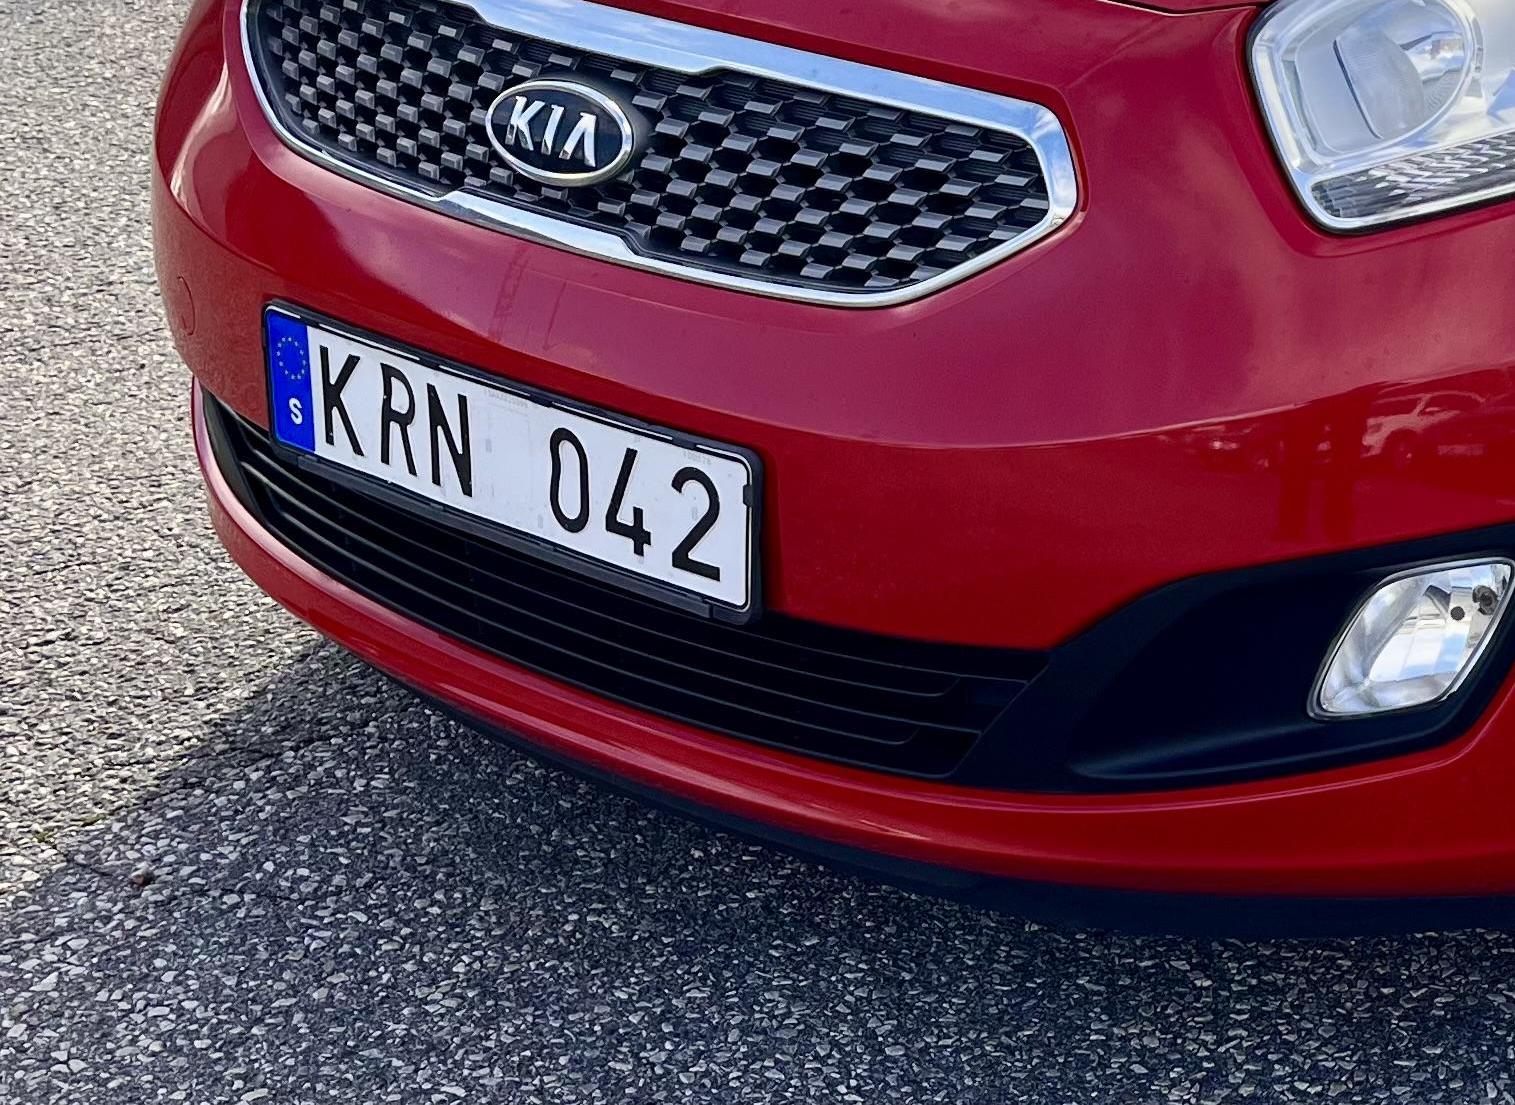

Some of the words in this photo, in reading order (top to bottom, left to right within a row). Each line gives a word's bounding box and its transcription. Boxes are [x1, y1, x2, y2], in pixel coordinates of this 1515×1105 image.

[505, 95, 597, 168] KIA
[288, 397, 303, 426] S
[319, 344, 473, 498] KRN
[549, 427, 721, 582] 042
